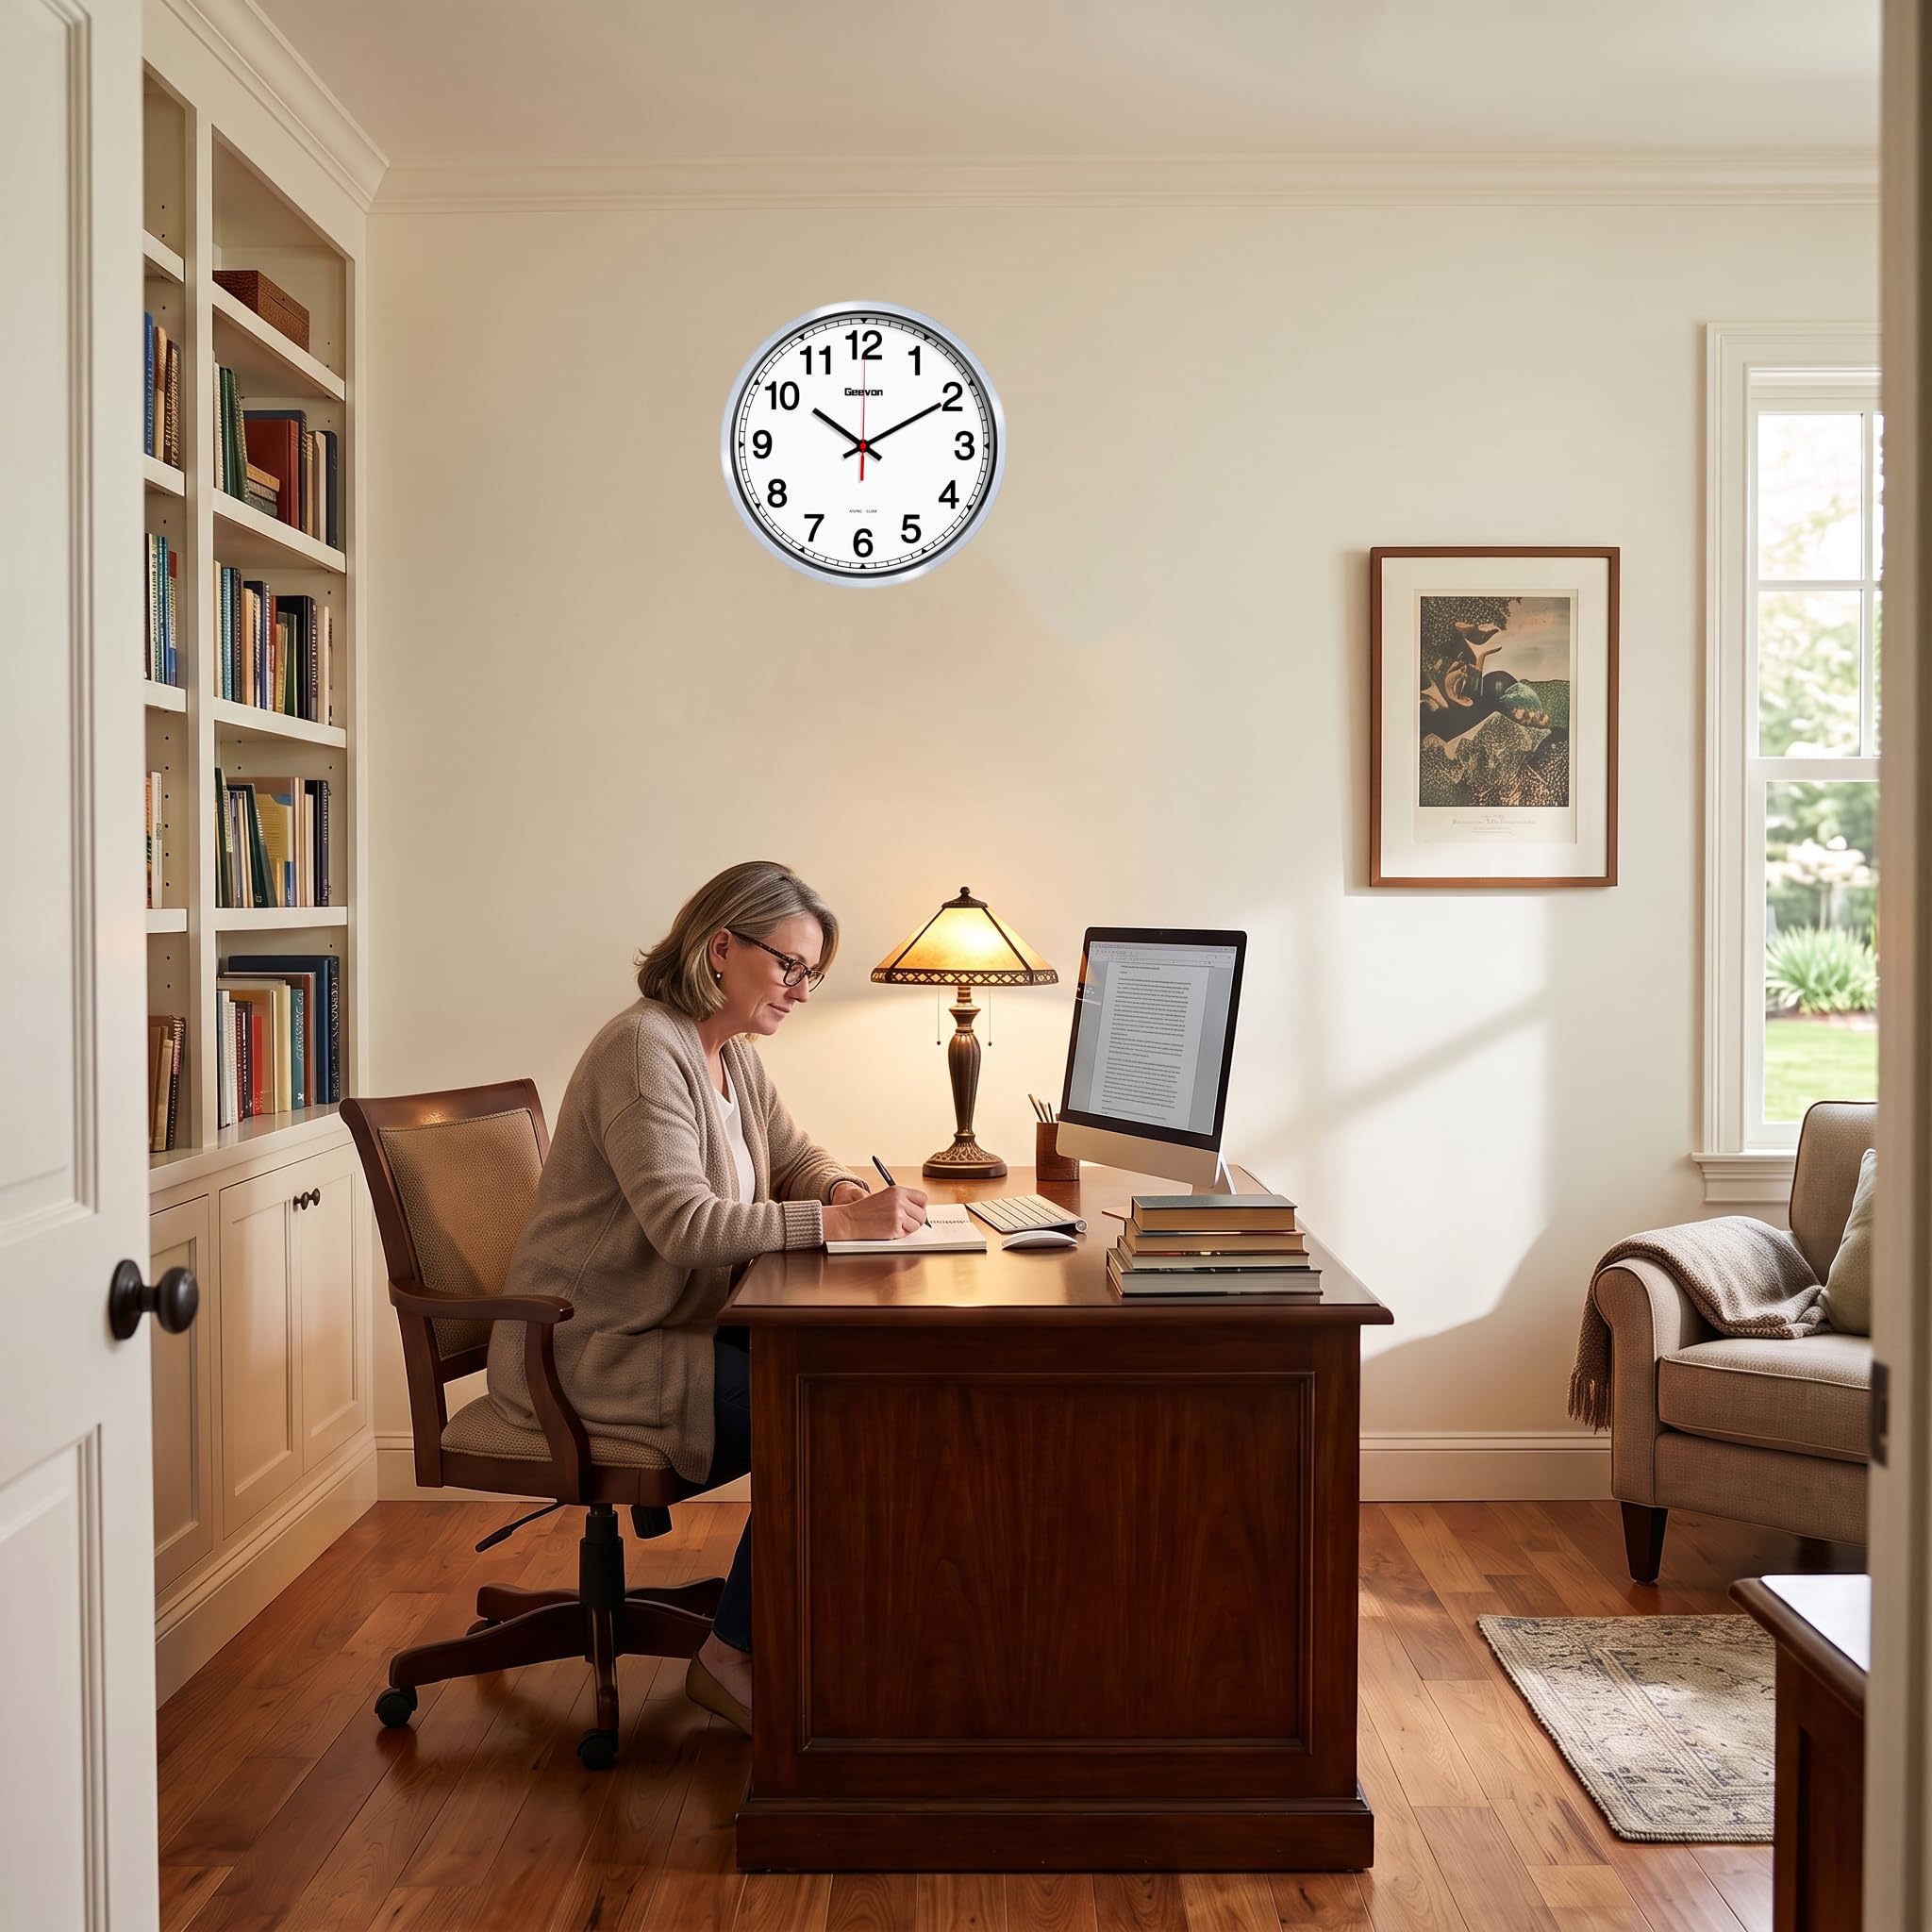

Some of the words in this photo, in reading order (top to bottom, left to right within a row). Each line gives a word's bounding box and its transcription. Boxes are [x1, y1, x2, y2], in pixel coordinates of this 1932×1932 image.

[800, 345, 831, 375] 11
[845, 330, 883, 360] 12
[908, 346, 921, 376] 1
[765, 381, 800, 410] 10
[844, 388, 883, 396] Geevon
[941, 382, 963, 412] 2
[752, 430, 773, 459] 9
[954, 431, 975, 461] 3
[767, 479, 788, 508] 8
[938, 480, 960, 509] 4
[804, 514, 825, 542] 7
[853, 528, 874, 558] 6
[901, 514, 922, 544] 5
